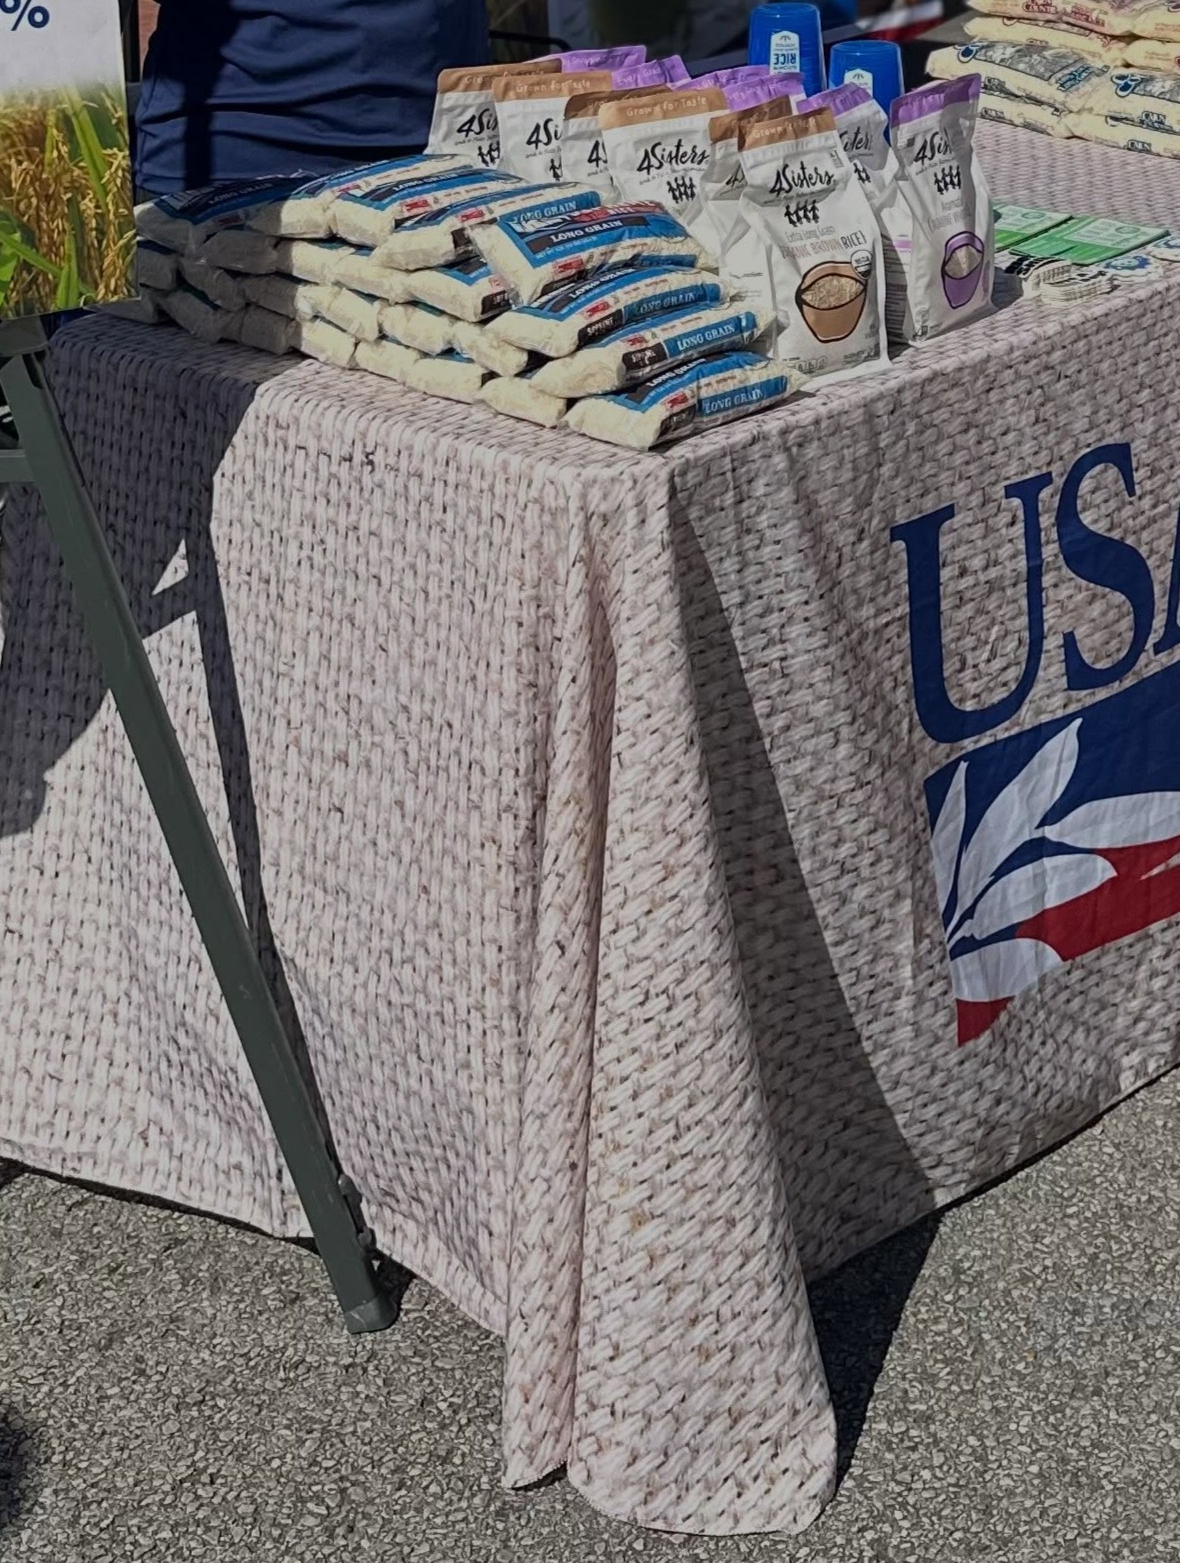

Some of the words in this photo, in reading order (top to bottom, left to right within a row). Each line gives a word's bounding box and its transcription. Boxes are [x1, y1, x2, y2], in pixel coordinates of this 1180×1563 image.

[773, 52, 797, 66] RICE
[626, 105, 661, 118] Grown
[662, 100, 678, 111] for
[680, 95, 707, 109] Taste
[543, 200, 577, 217] GRAIN
[550, 227, 584, 243] LONG
[585, 220, 624, 234] GRAIN
[663, 292, 696, 307] GRAIN
[676, 334, 704, 351] LONG
[704, 324, 736, 341] GRAIN
[648, 370, 677, 387] LONG
[704, 397, 732, 415] LONG
[733, 388, 764, 405] GRAIN
